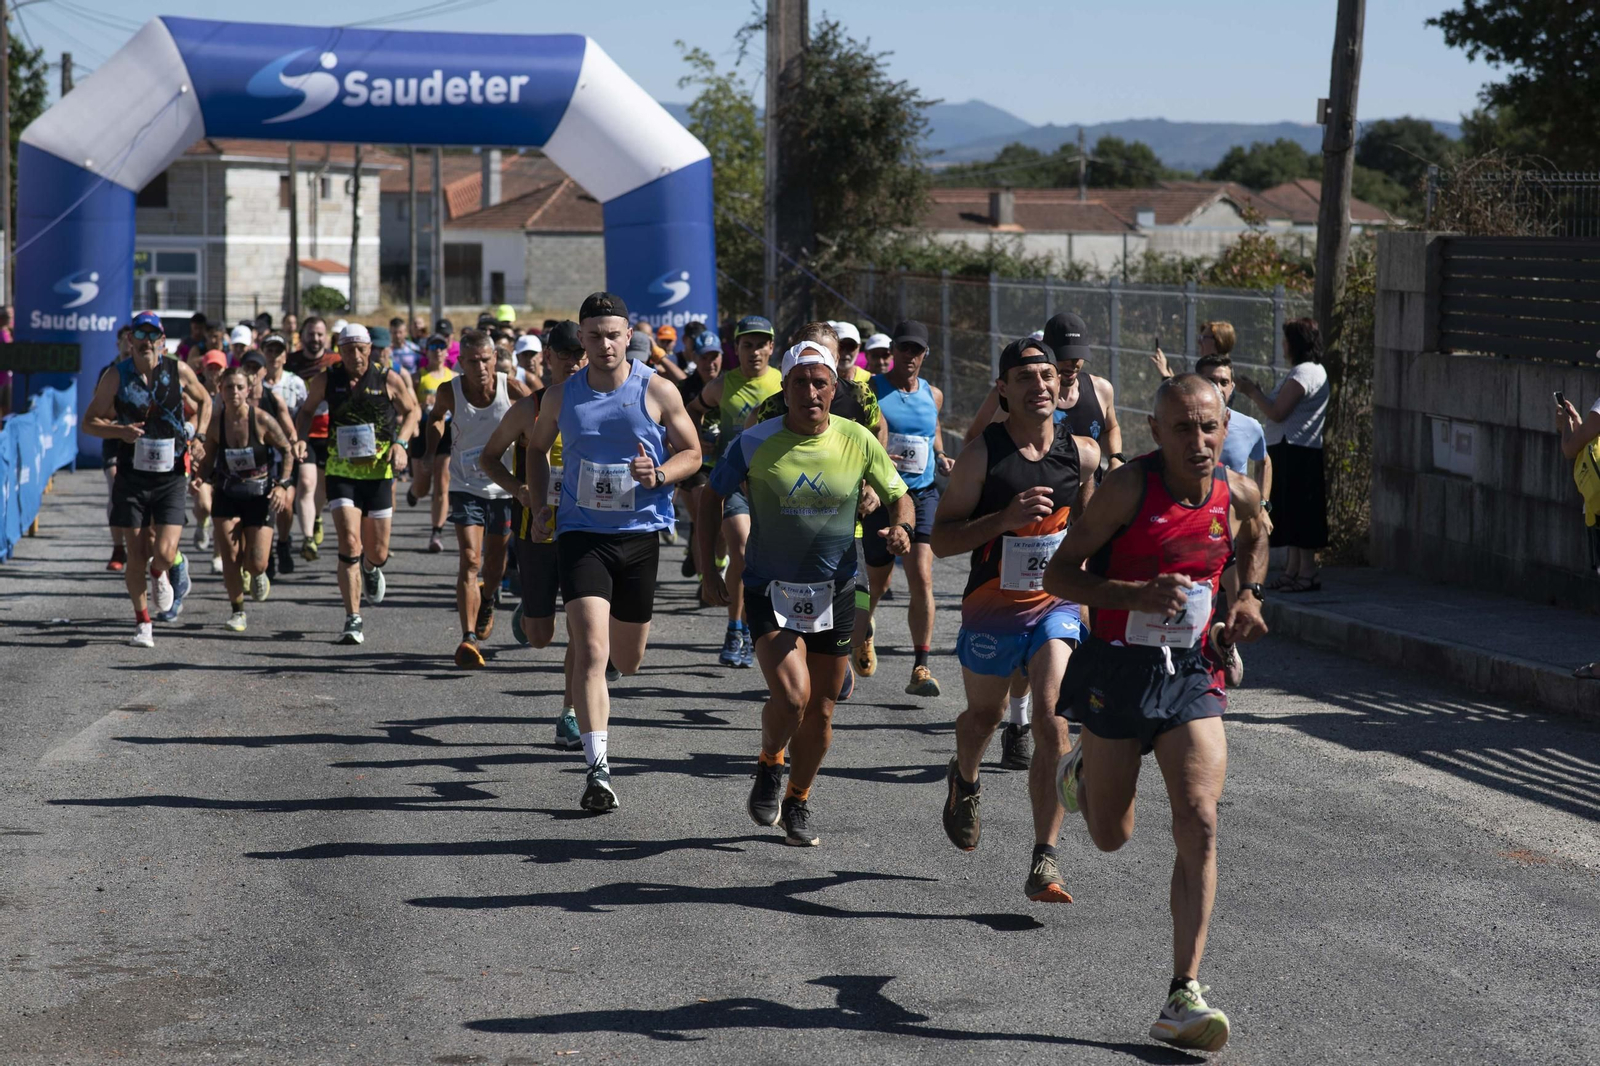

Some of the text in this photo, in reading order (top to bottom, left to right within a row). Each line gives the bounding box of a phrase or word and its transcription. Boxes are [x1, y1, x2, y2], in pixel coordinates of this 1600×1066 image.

[342, 69, 530, 107] Saudeter
[30, 309, 117, 332] Saudeter
[149, 451, 161, 460] 31
[901, 449, 916, 459] 49
[596, 482, 613, 494] 51
[1028, 557, 1049, 571] 26
[793, 602, 814, 614] 68
